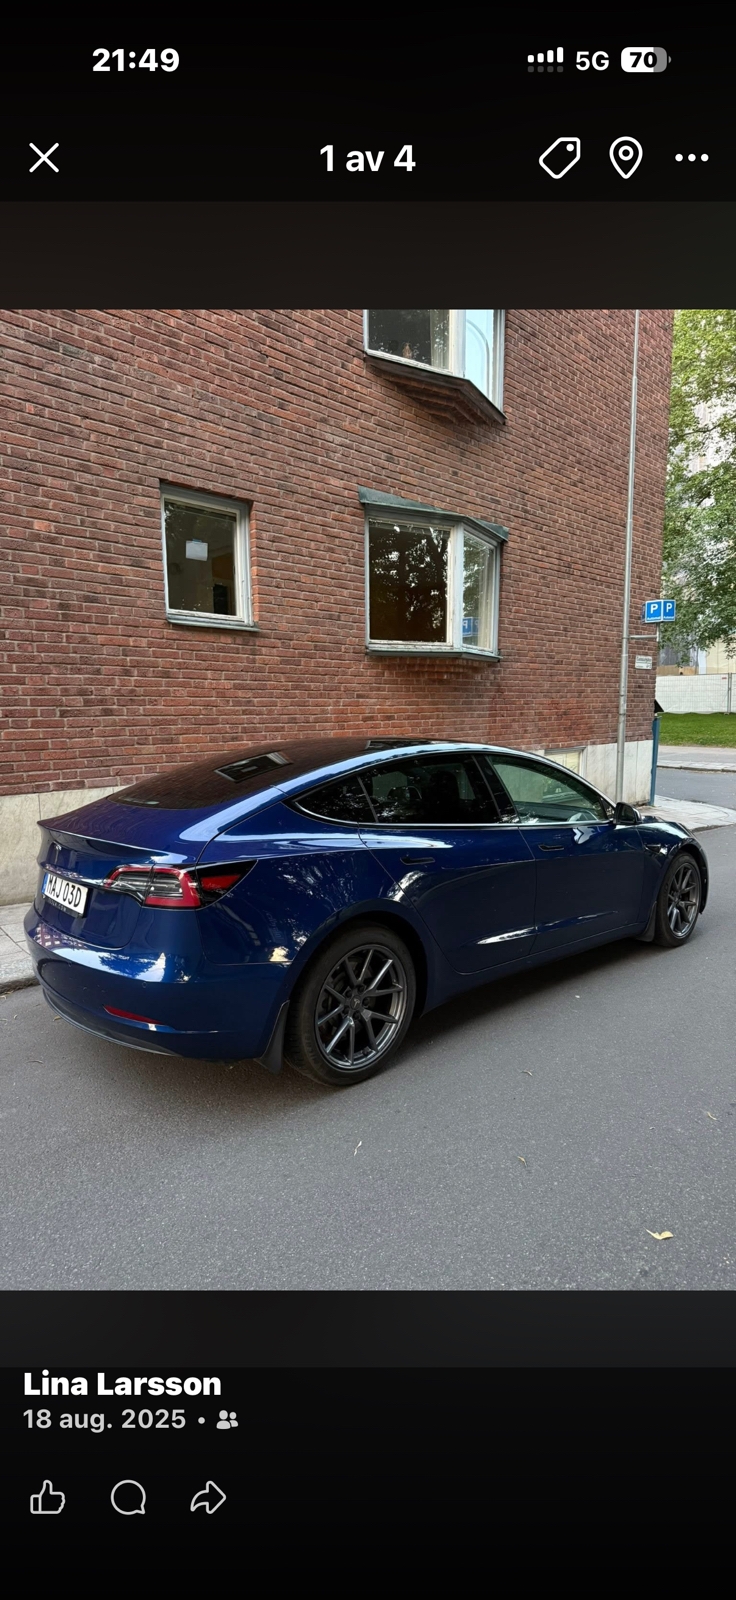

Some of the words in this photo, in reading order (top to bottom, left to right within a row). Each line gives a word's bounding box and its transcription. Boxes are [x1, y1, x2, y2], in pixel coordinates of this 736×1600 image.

[651, 604, 658, 613] P
[666, 603, 672, 612] P
[63, 883, 82, 907] 03D
